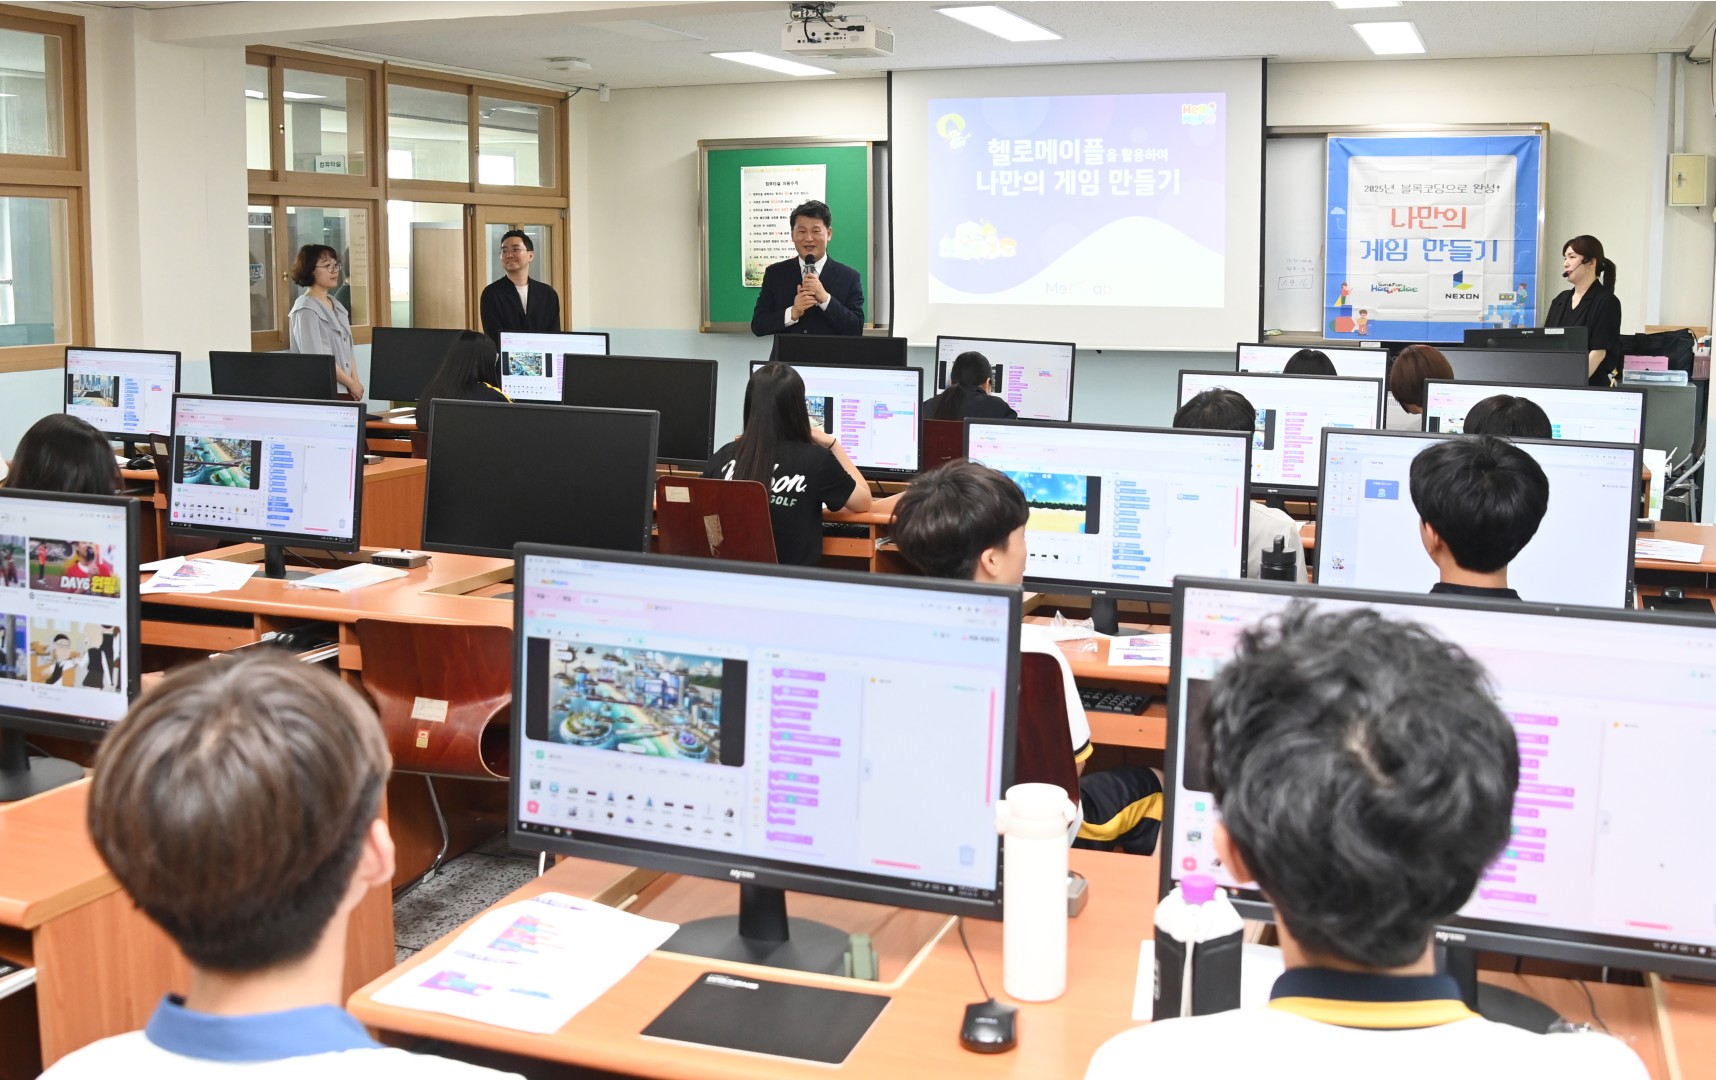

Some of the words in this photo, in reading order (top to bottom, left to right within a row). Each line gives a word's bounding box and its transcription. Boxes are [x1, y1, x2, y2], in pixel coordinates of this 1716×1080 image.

[987, 138, 1118, 167] 헬로메이플을
[1121, 148, 1169, 163] 활용하여
[320, 161, 342, 169] 컴퓨터실
[976, 169, 1045, 196] 나만의
[1054, 169, 1100, 196] 게임
[1109, 168, 1180, 196] 만들기
[1364, 183, 1395, 194] 2025년
[1401, 183, 1468, 194] 블록코딩으로
[1473, 183, 1501, 194] 완성!
[1391, 206, 1467, 229] 나만의
[1360, 238, 1408, 262] 게임
[1422, 238, 1498, 262] 만들기
[60, 575, 91, 590] DAY6
